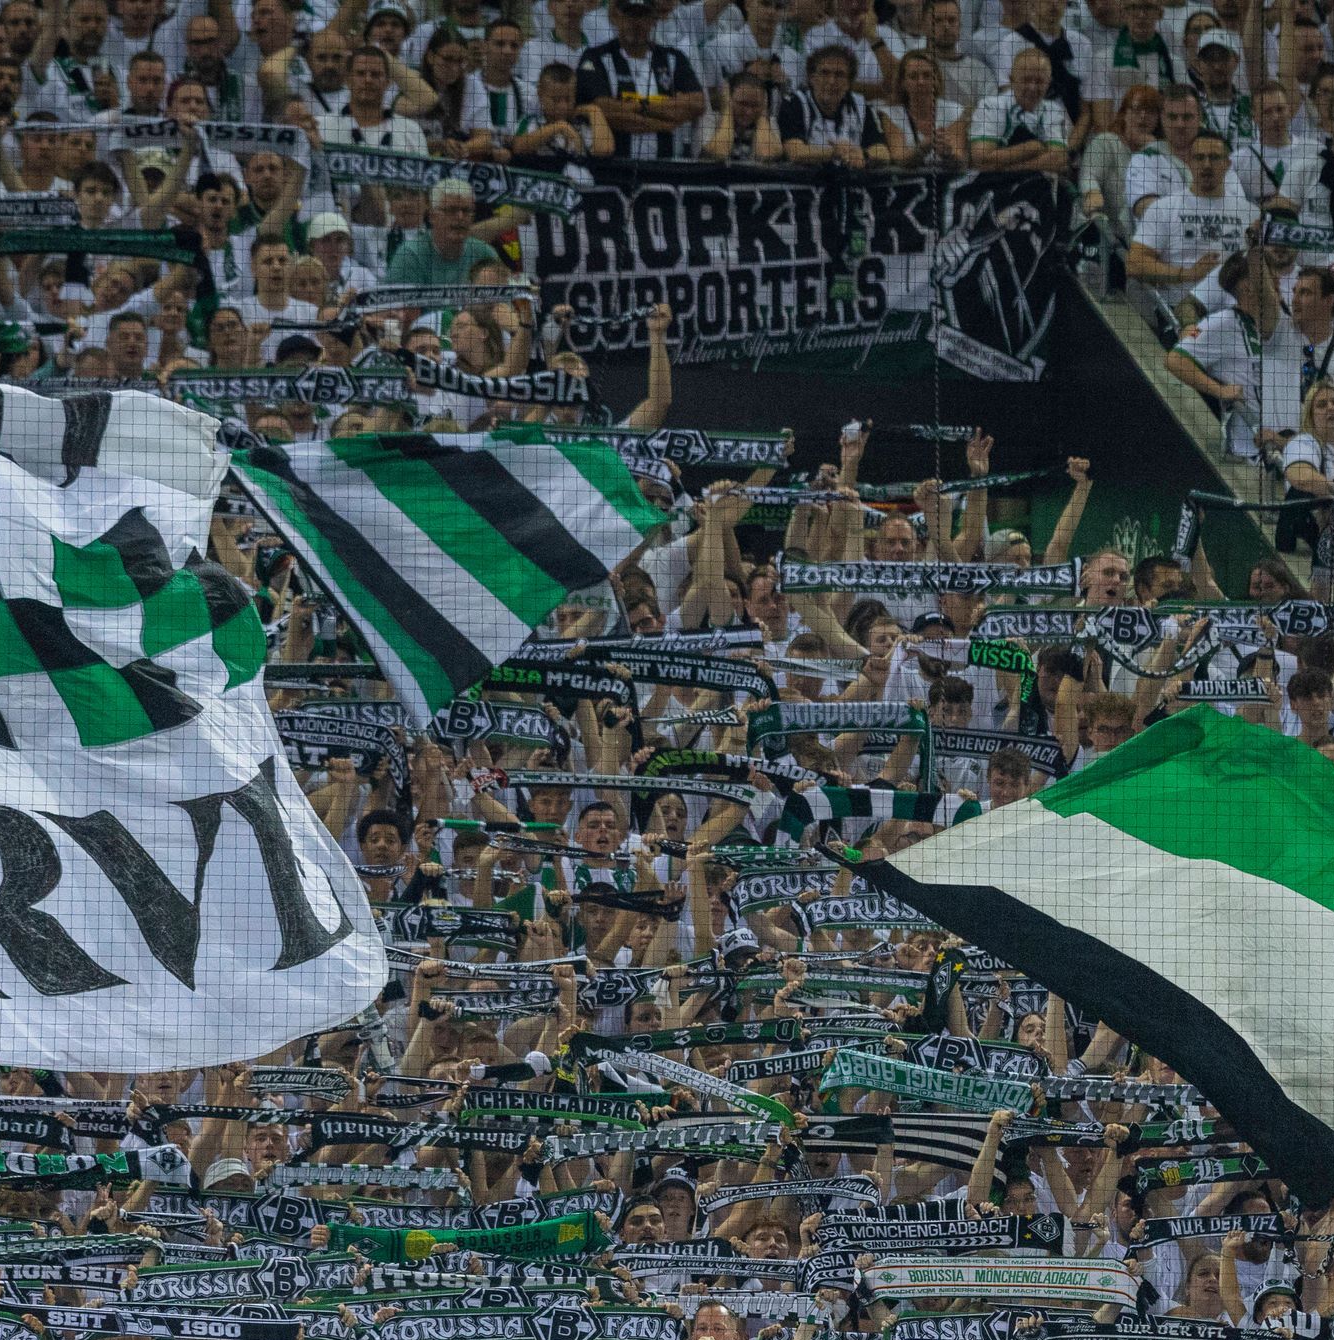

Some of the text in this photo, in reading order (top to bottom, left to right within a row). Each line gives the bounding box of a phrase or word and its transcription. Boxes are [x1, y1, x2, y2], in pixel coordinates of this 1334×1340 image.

[783, 567, 1071, 590] BORUSSIA FANS
[549, 1193, 613, 1216] FANS
[853, 1218, 1009, 1240] MÖNCHENGLADBACH
[1171, 1216, 1277, 1234] NUR DER VFL
[865, 1238, 942, 1248] SIND BORUSSIA
[135, 1272, 250, 1300] BORUSSIA
[908, 1269, 1088, 1287] BORUSSIA MÖNCHENGLADBACH
[48, 1313, 240, 1338] SEIT 1900
[602, 1314, 677, 1340] FANS
[1161, 1324, 1195, 1338] DER
[1199, 1326, 1227, 1338] VFL
